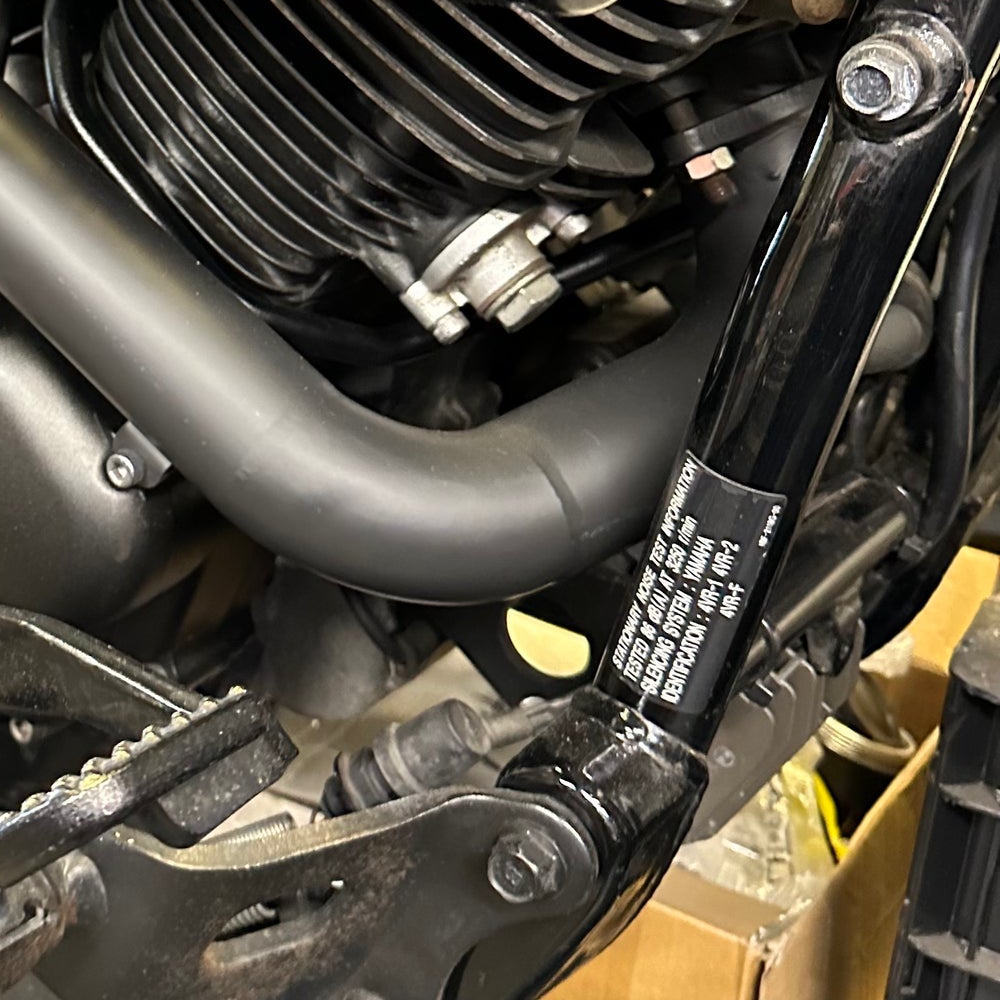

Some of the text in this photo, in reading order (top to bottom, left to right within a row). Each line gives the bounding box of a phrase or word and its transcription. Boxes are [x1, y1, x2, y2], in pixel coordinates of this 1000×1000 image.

[677, 515, 698, 546] r/min
[612, 458, 699, 670] STATIONARY NOISE TEST INFORMATION
[665, 543, 687, 574] 3250
[658, 569, 675, 592] AT
[640, 636, 676, 695] SILENCING
[662, 589, 693, 638] SYSTEM
[682, 535, 715, 583] YAMAHA
[647, 588, 669, 625] dB(A)
[719, 582, 745, 618] 4VR-F
[660, 621, 707, 704] IDENTIFICATION
[697, 578, 724, 614] 4VR-1
[711, 540, 740, 577] 4VR-2
[623, 637, 650, 682] TESTED
